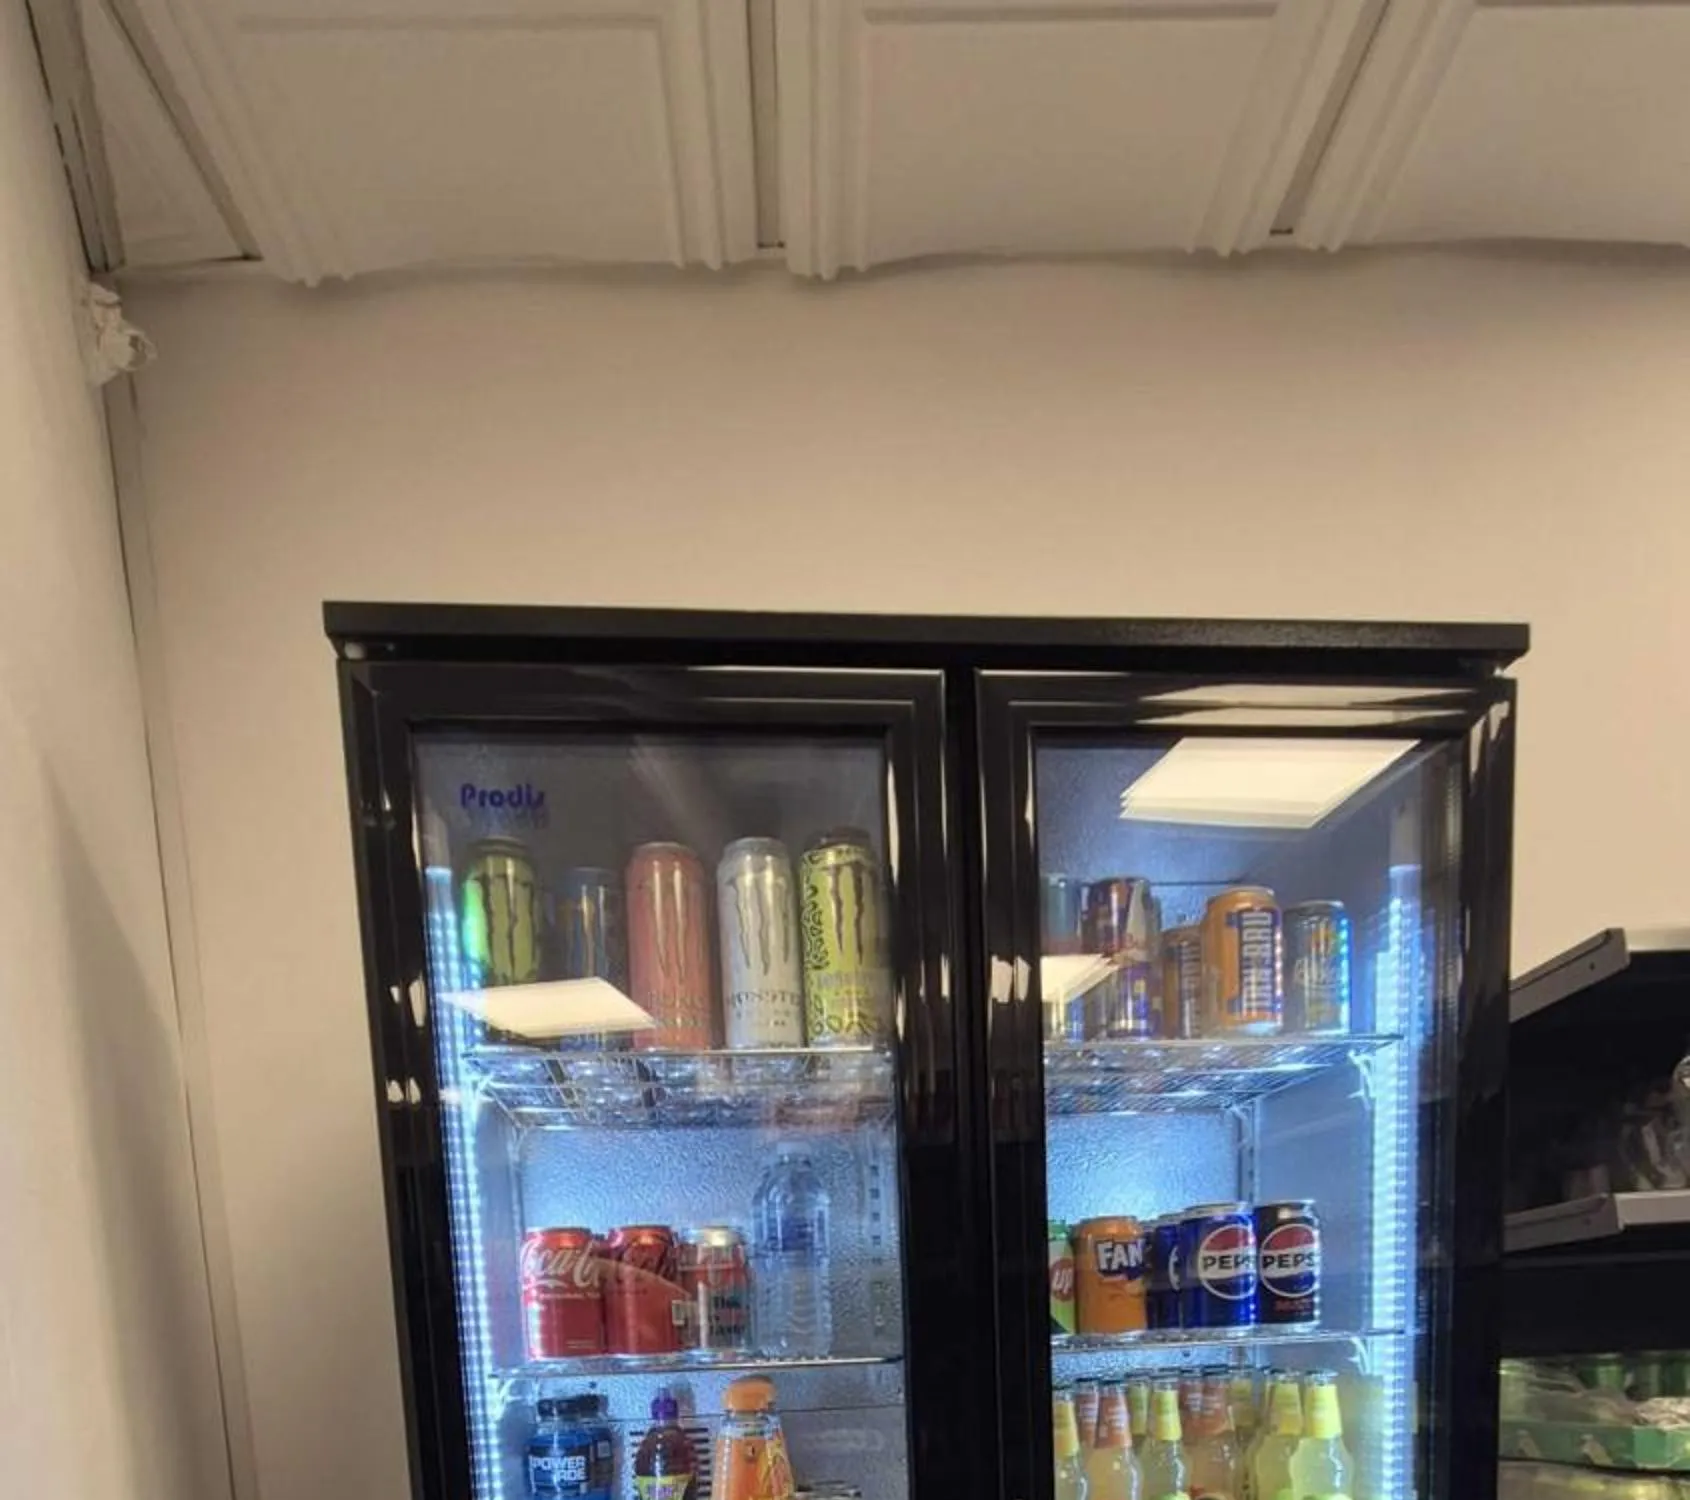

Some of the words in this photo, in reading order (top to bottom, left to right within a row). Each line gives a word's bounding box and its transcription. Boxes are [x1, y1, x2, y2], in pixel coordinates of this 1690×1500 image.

[1097, 1238, 1146, 1270] FAN
[1263, 1252, 1316, 1270] PEPS
[529, 1455, 586, 1471] POWER
